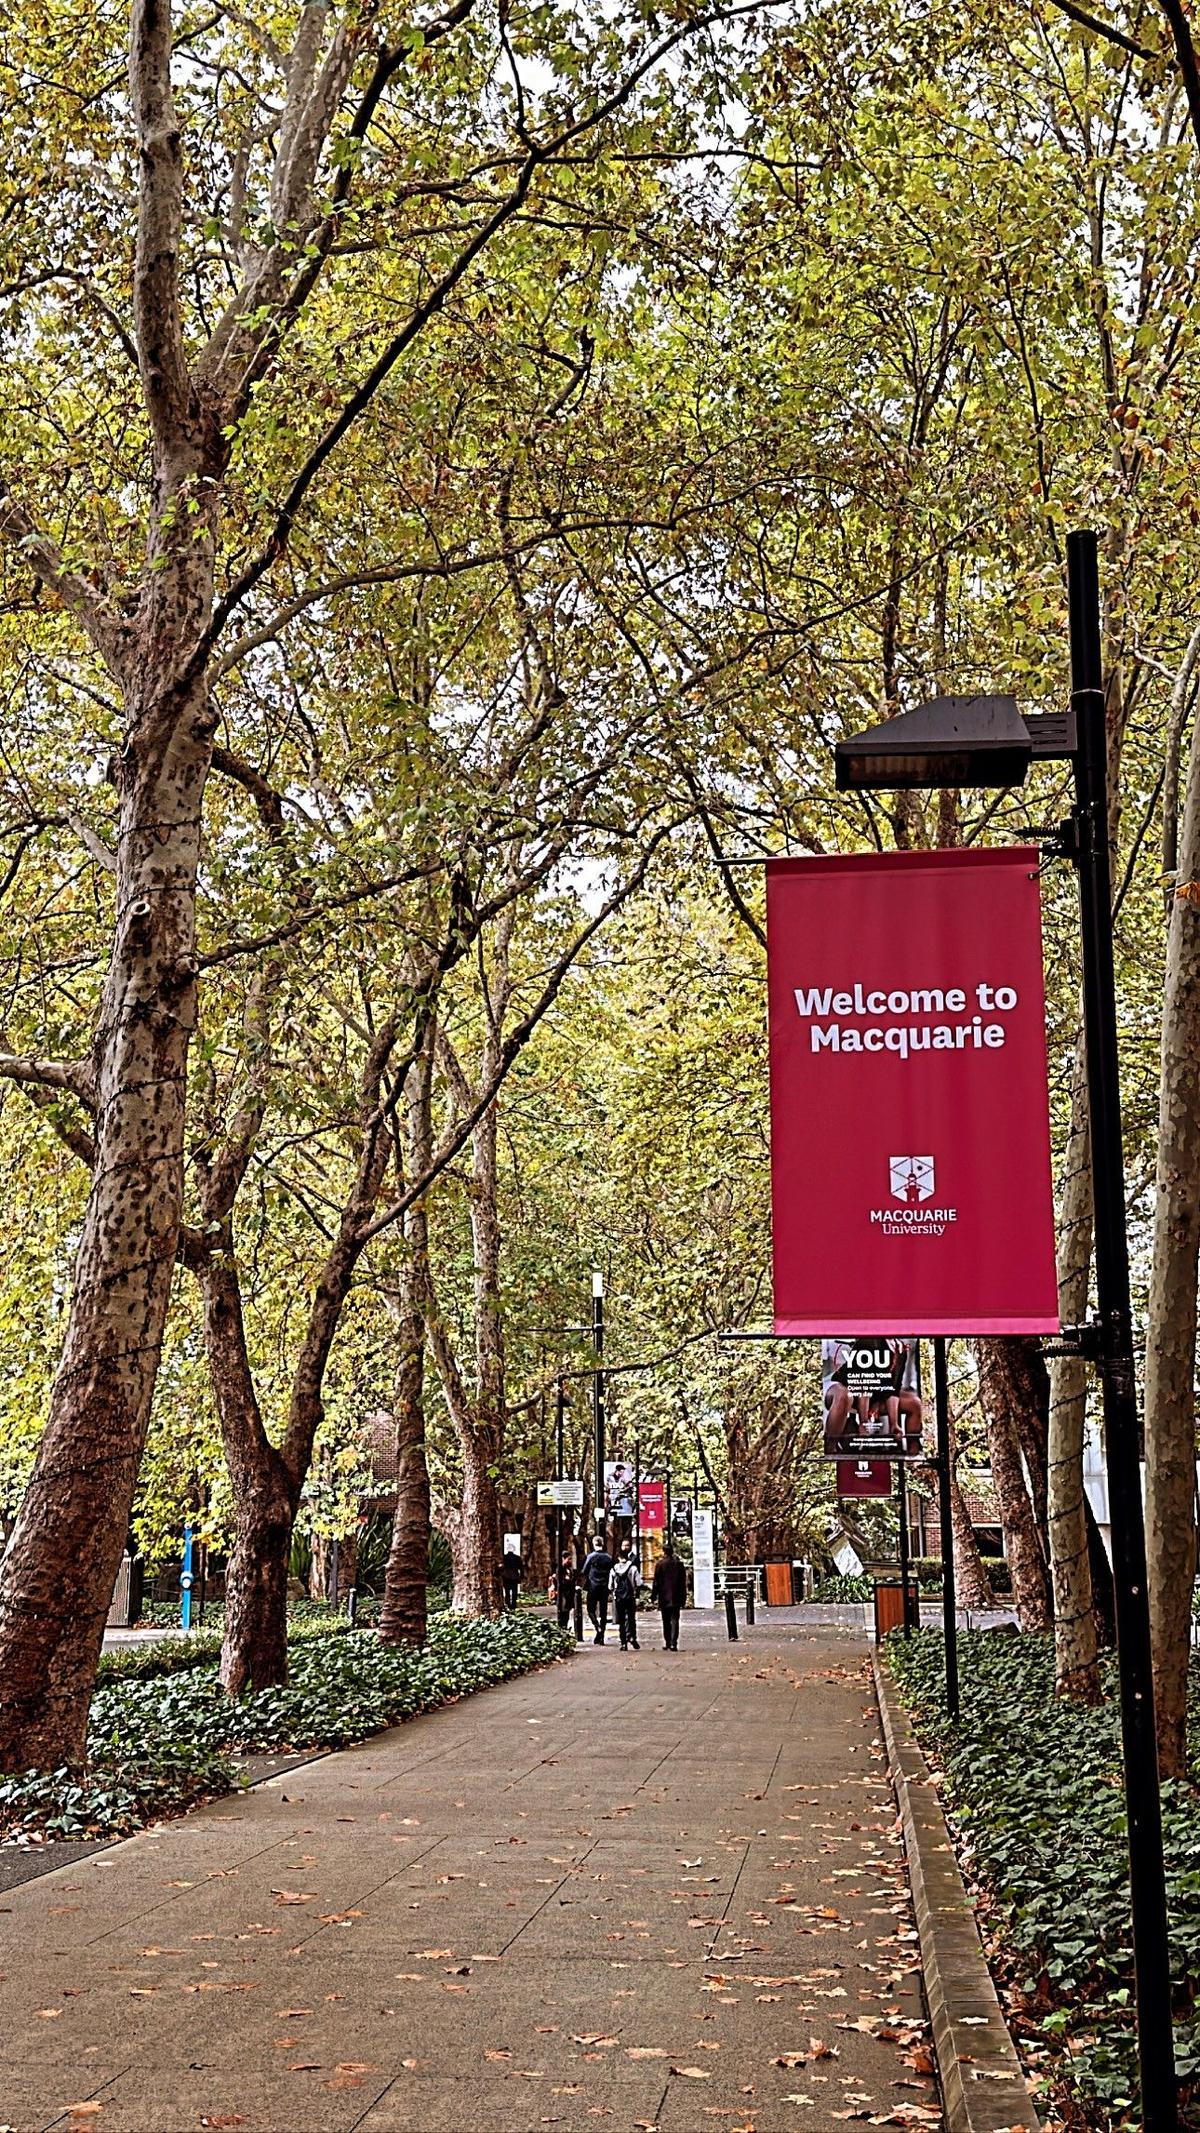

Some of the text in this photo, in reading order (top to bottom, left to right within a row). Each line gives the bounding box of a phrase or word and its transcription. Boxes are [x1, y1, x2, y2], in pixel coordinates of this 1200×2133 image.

[794, 983, 1018, 1016] Welcome to
[811, 1016, 1004, 1058] Macquarie
[870, 1209, 958, 1224] MACQUARIE
[882, 1223, 946, 1236] University
[842, 1349, 890, 1368] YOU
